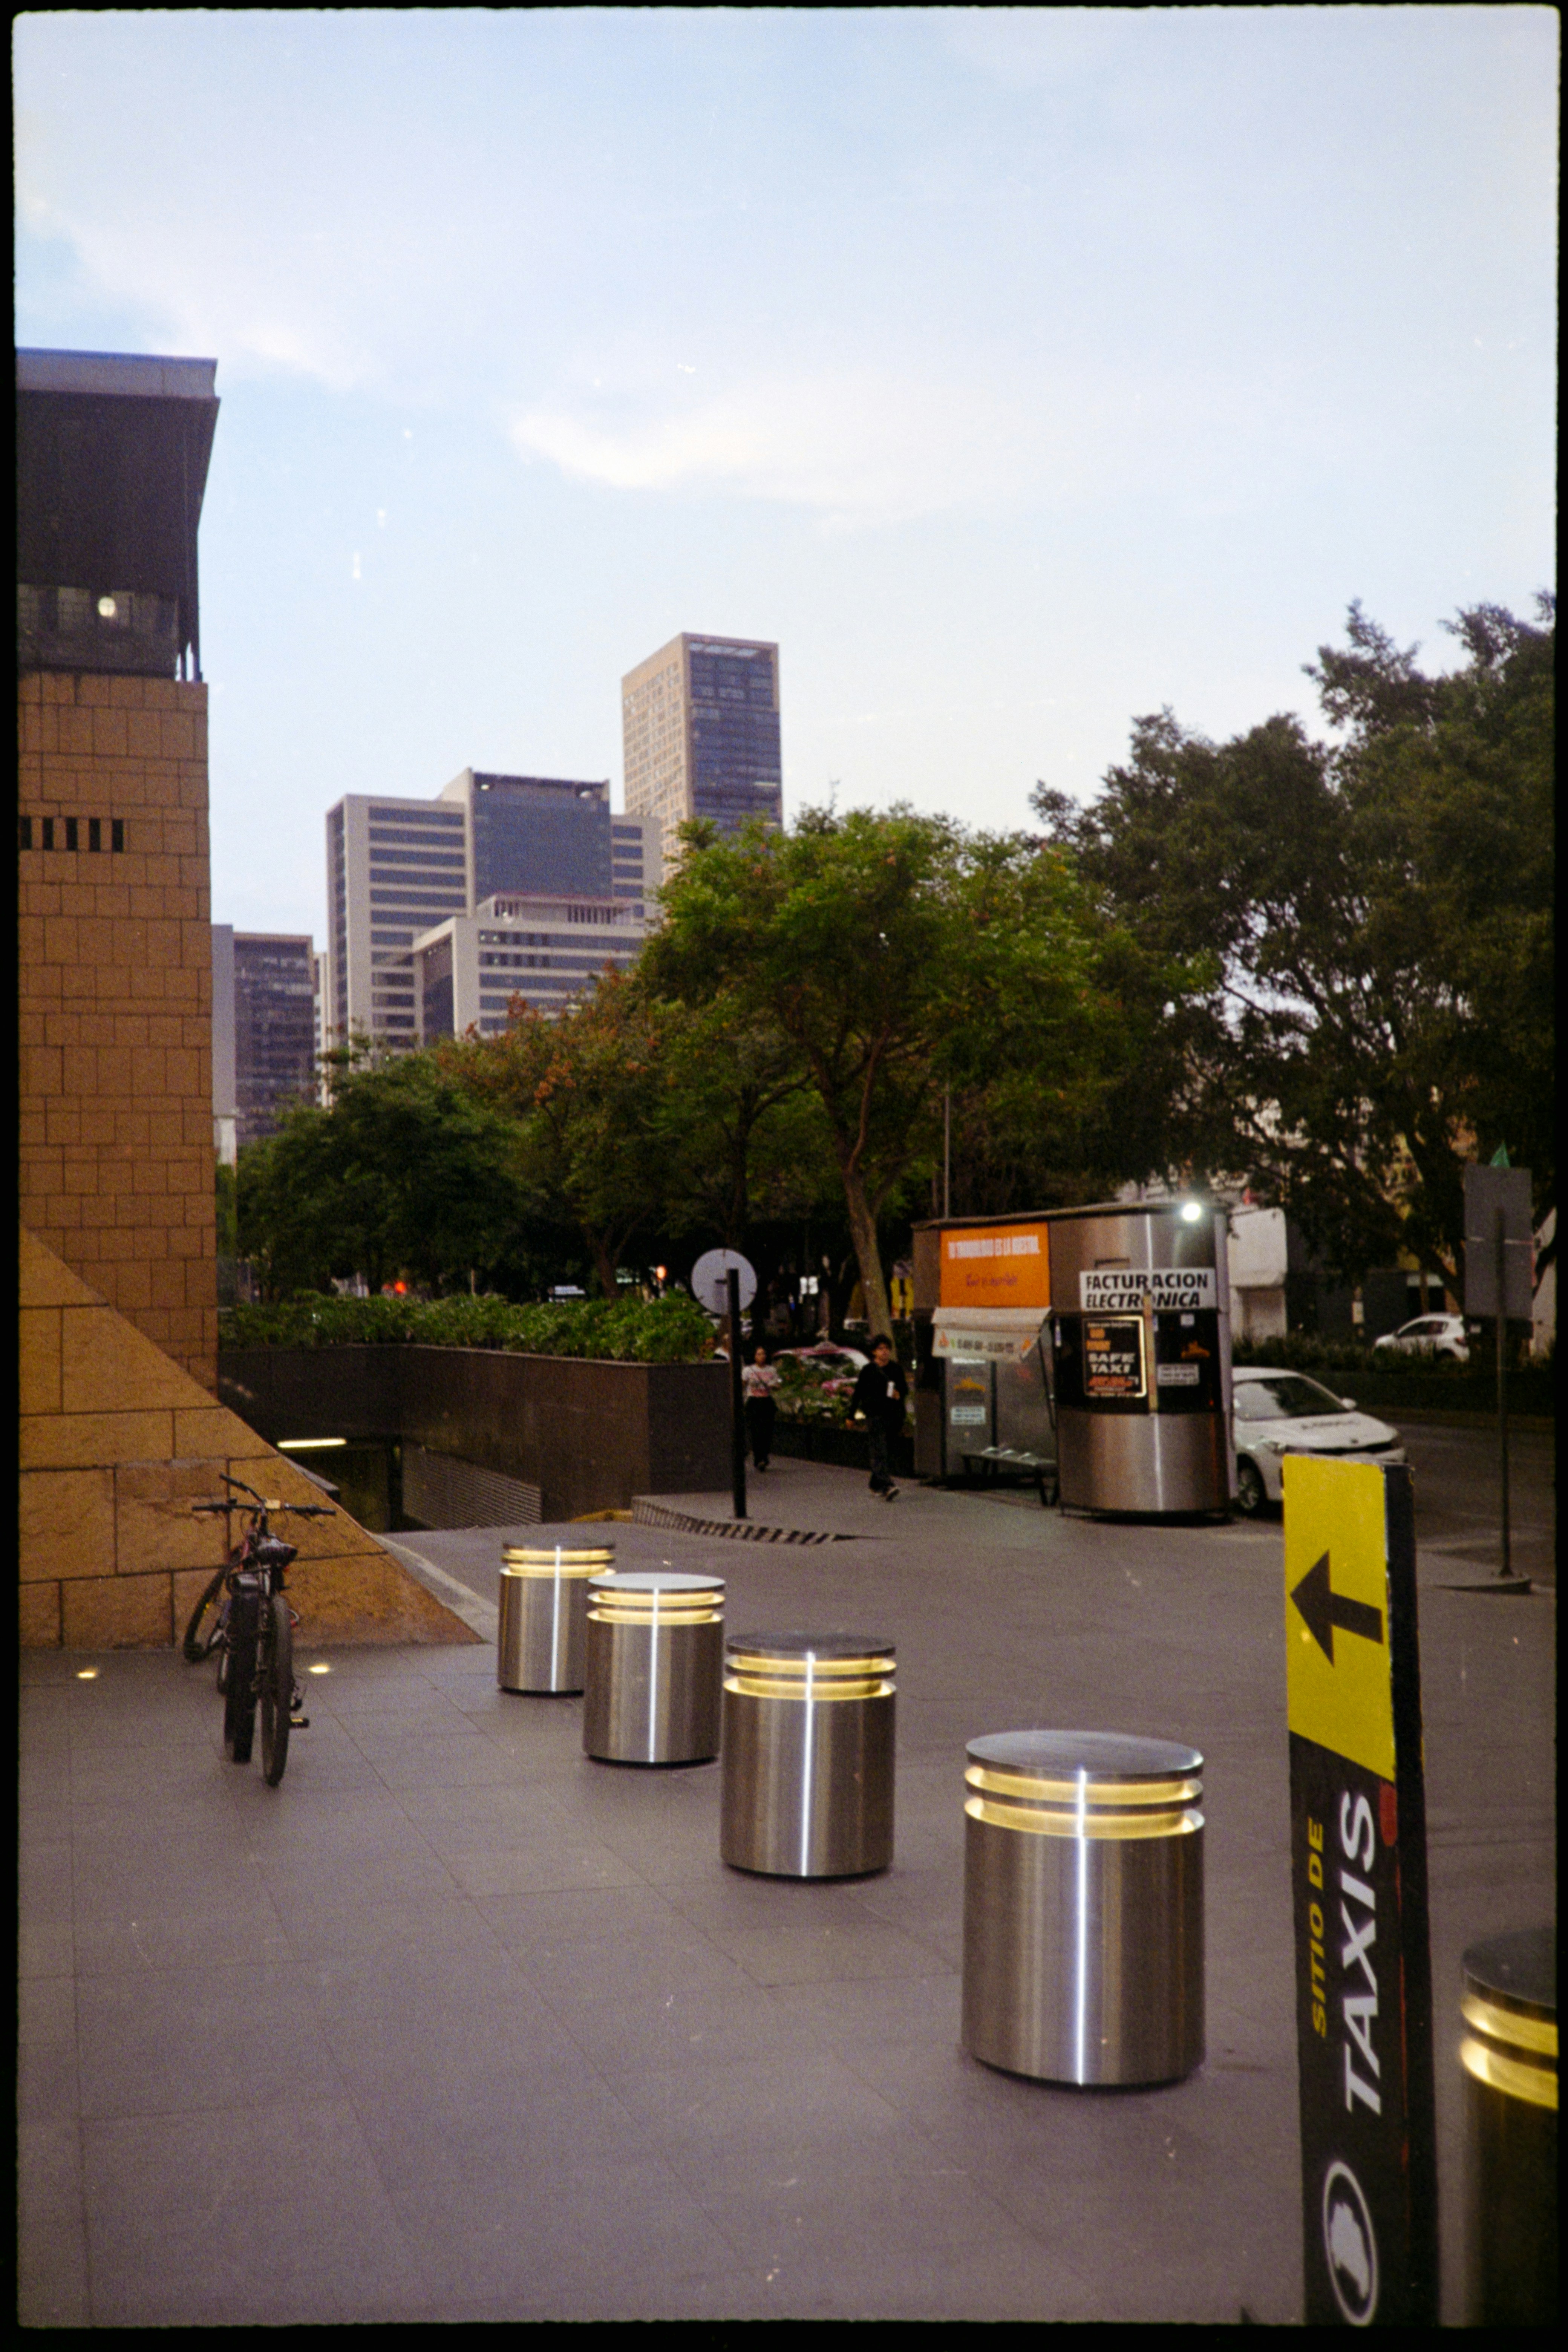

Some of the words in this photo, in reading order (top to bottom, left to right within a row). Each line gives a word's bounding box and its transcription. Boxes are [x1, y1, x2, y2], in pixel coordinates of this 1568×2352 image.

[1086, 1273, 1208, 1290] FACTURACION
[1090, 1364, 1130, 1373] TAXI
[1308, 1816, 1324, 1890] DE
[1309, 1902, 1327, 2038] SITIO
[1340, 1791, 1381, 2116] TAXIS
